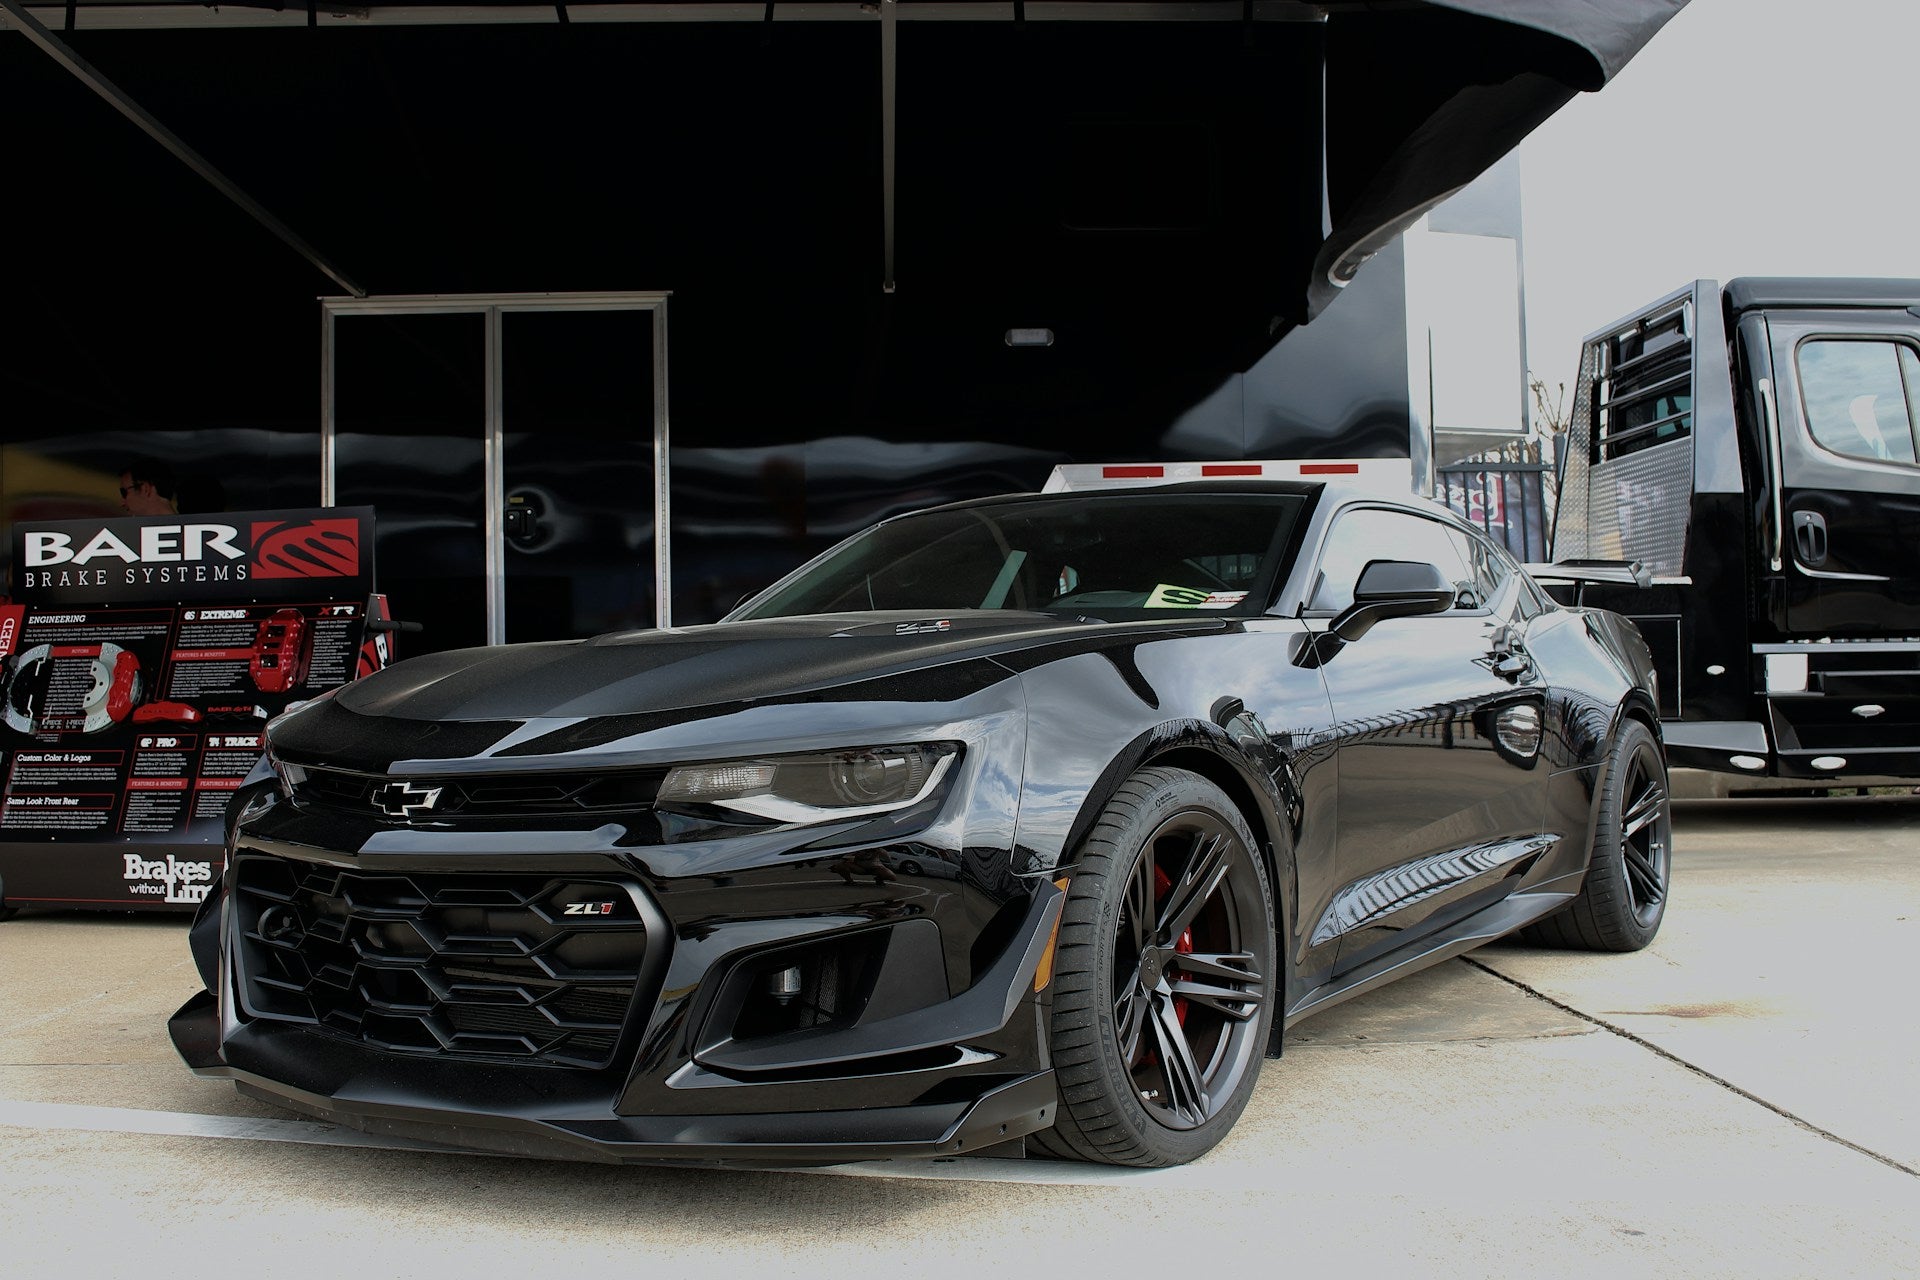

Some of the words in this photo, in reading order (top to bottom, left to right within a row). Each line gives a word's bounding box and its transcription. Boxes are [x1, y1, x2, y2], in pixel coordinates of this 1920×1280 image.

[25, 524, 247, 567] BAER
[25, 569, 108, 588] BRAKE
[125, 565, 248, 585] SYSTEMS
[28, 614, 87, 624] ENGINEERING
[17, 753, 43, 762] Custom
[43, 753, 63, 762] Color
[63, 753, 70, 762] &
[70, 753, 92, 764] Logos
[131, 780, 156, 788] FEATURES
[6, 797, 26, 805] Same
[26, 797, 43, 805] Look
[43, 797, 62, 805] Front
[62, 797, 80, 805] Rear
[123, 853, 212, 883] Brakes
[128, 882, 166, 895] without
[563, 901, 615, 915] ZL1
